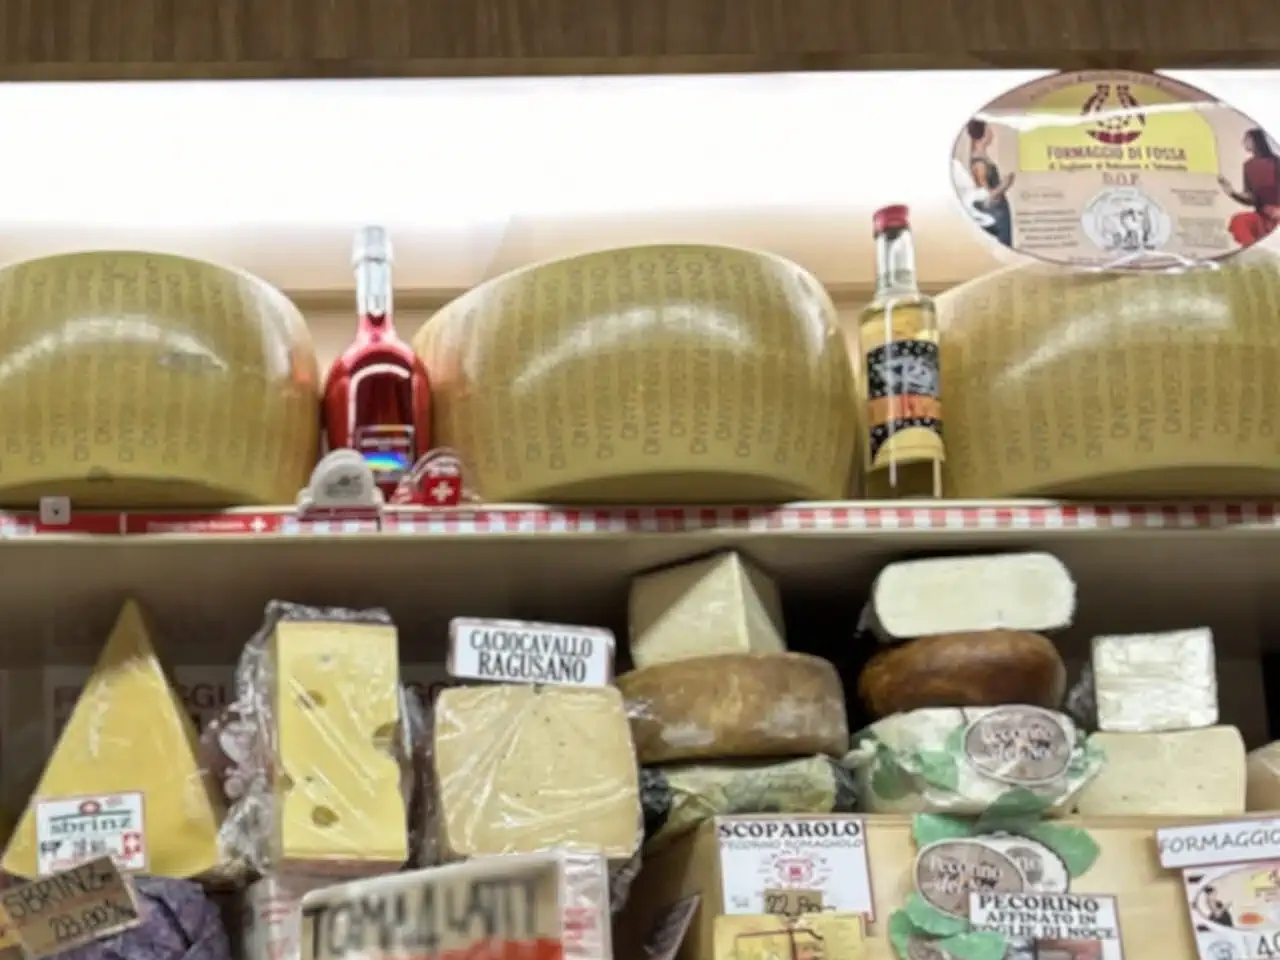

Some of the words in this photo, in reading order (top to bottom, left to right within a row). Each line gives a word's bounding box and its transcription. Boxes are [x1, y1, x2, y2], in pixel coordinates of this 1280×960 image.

[471, 628, 593, 659] CACIOCAVALLO
[478, 651, 588, 684] RAGUSANO
[719, 821, 860, 839] SCOPAROLO
[979, 894, 1099, 913] PECORINO
[986, 912, 1072, 925] AFFINATO
[1079, 912, 1097, 925] IN
